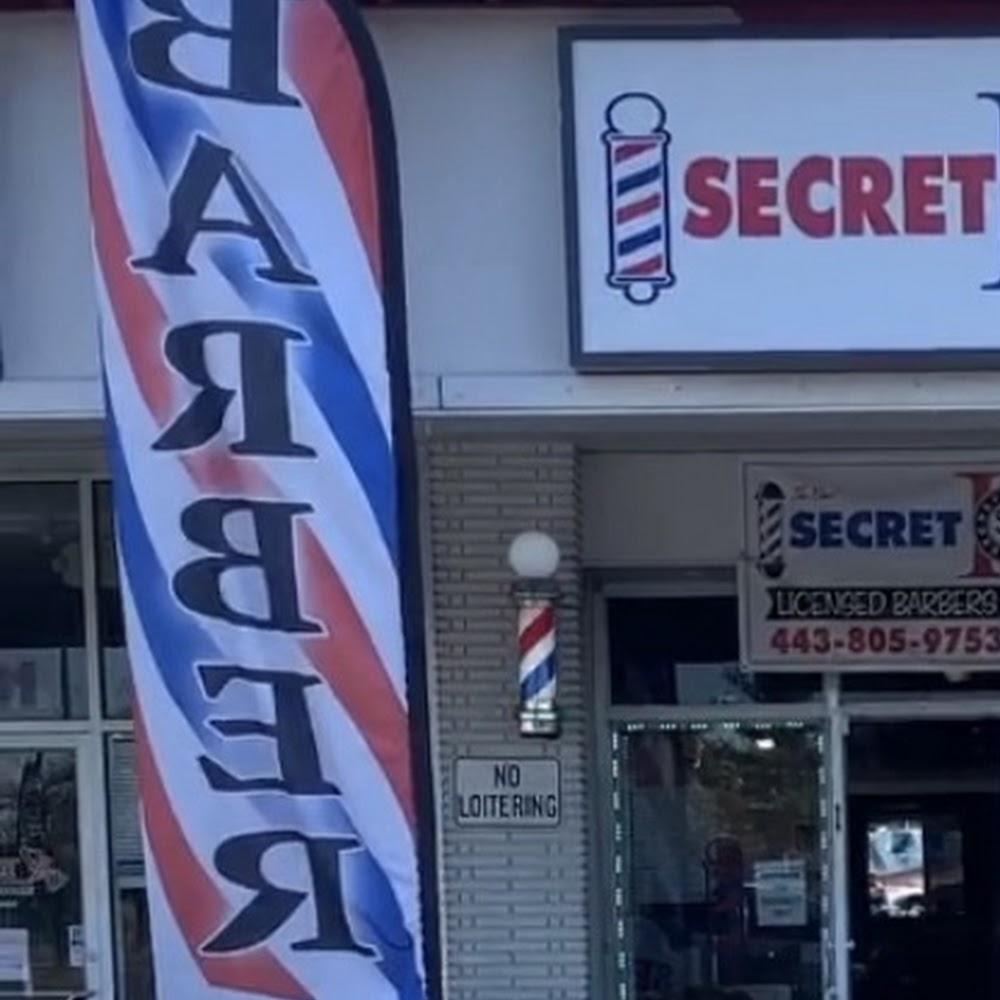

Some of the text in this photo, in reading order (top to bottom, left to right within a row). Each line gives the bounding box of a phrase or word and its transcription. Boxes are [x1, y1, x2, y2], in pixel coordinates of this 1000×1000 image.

[682, 154, 996, 239] SECRET
[789, 511, 963, 549] SECRET
[776, 590, 887, 616] LICENSED
[892, 589, 998, 615] BARBERS
[494, 764, 520, 789] NO
[458, 794, 557, 818] LOITERING
